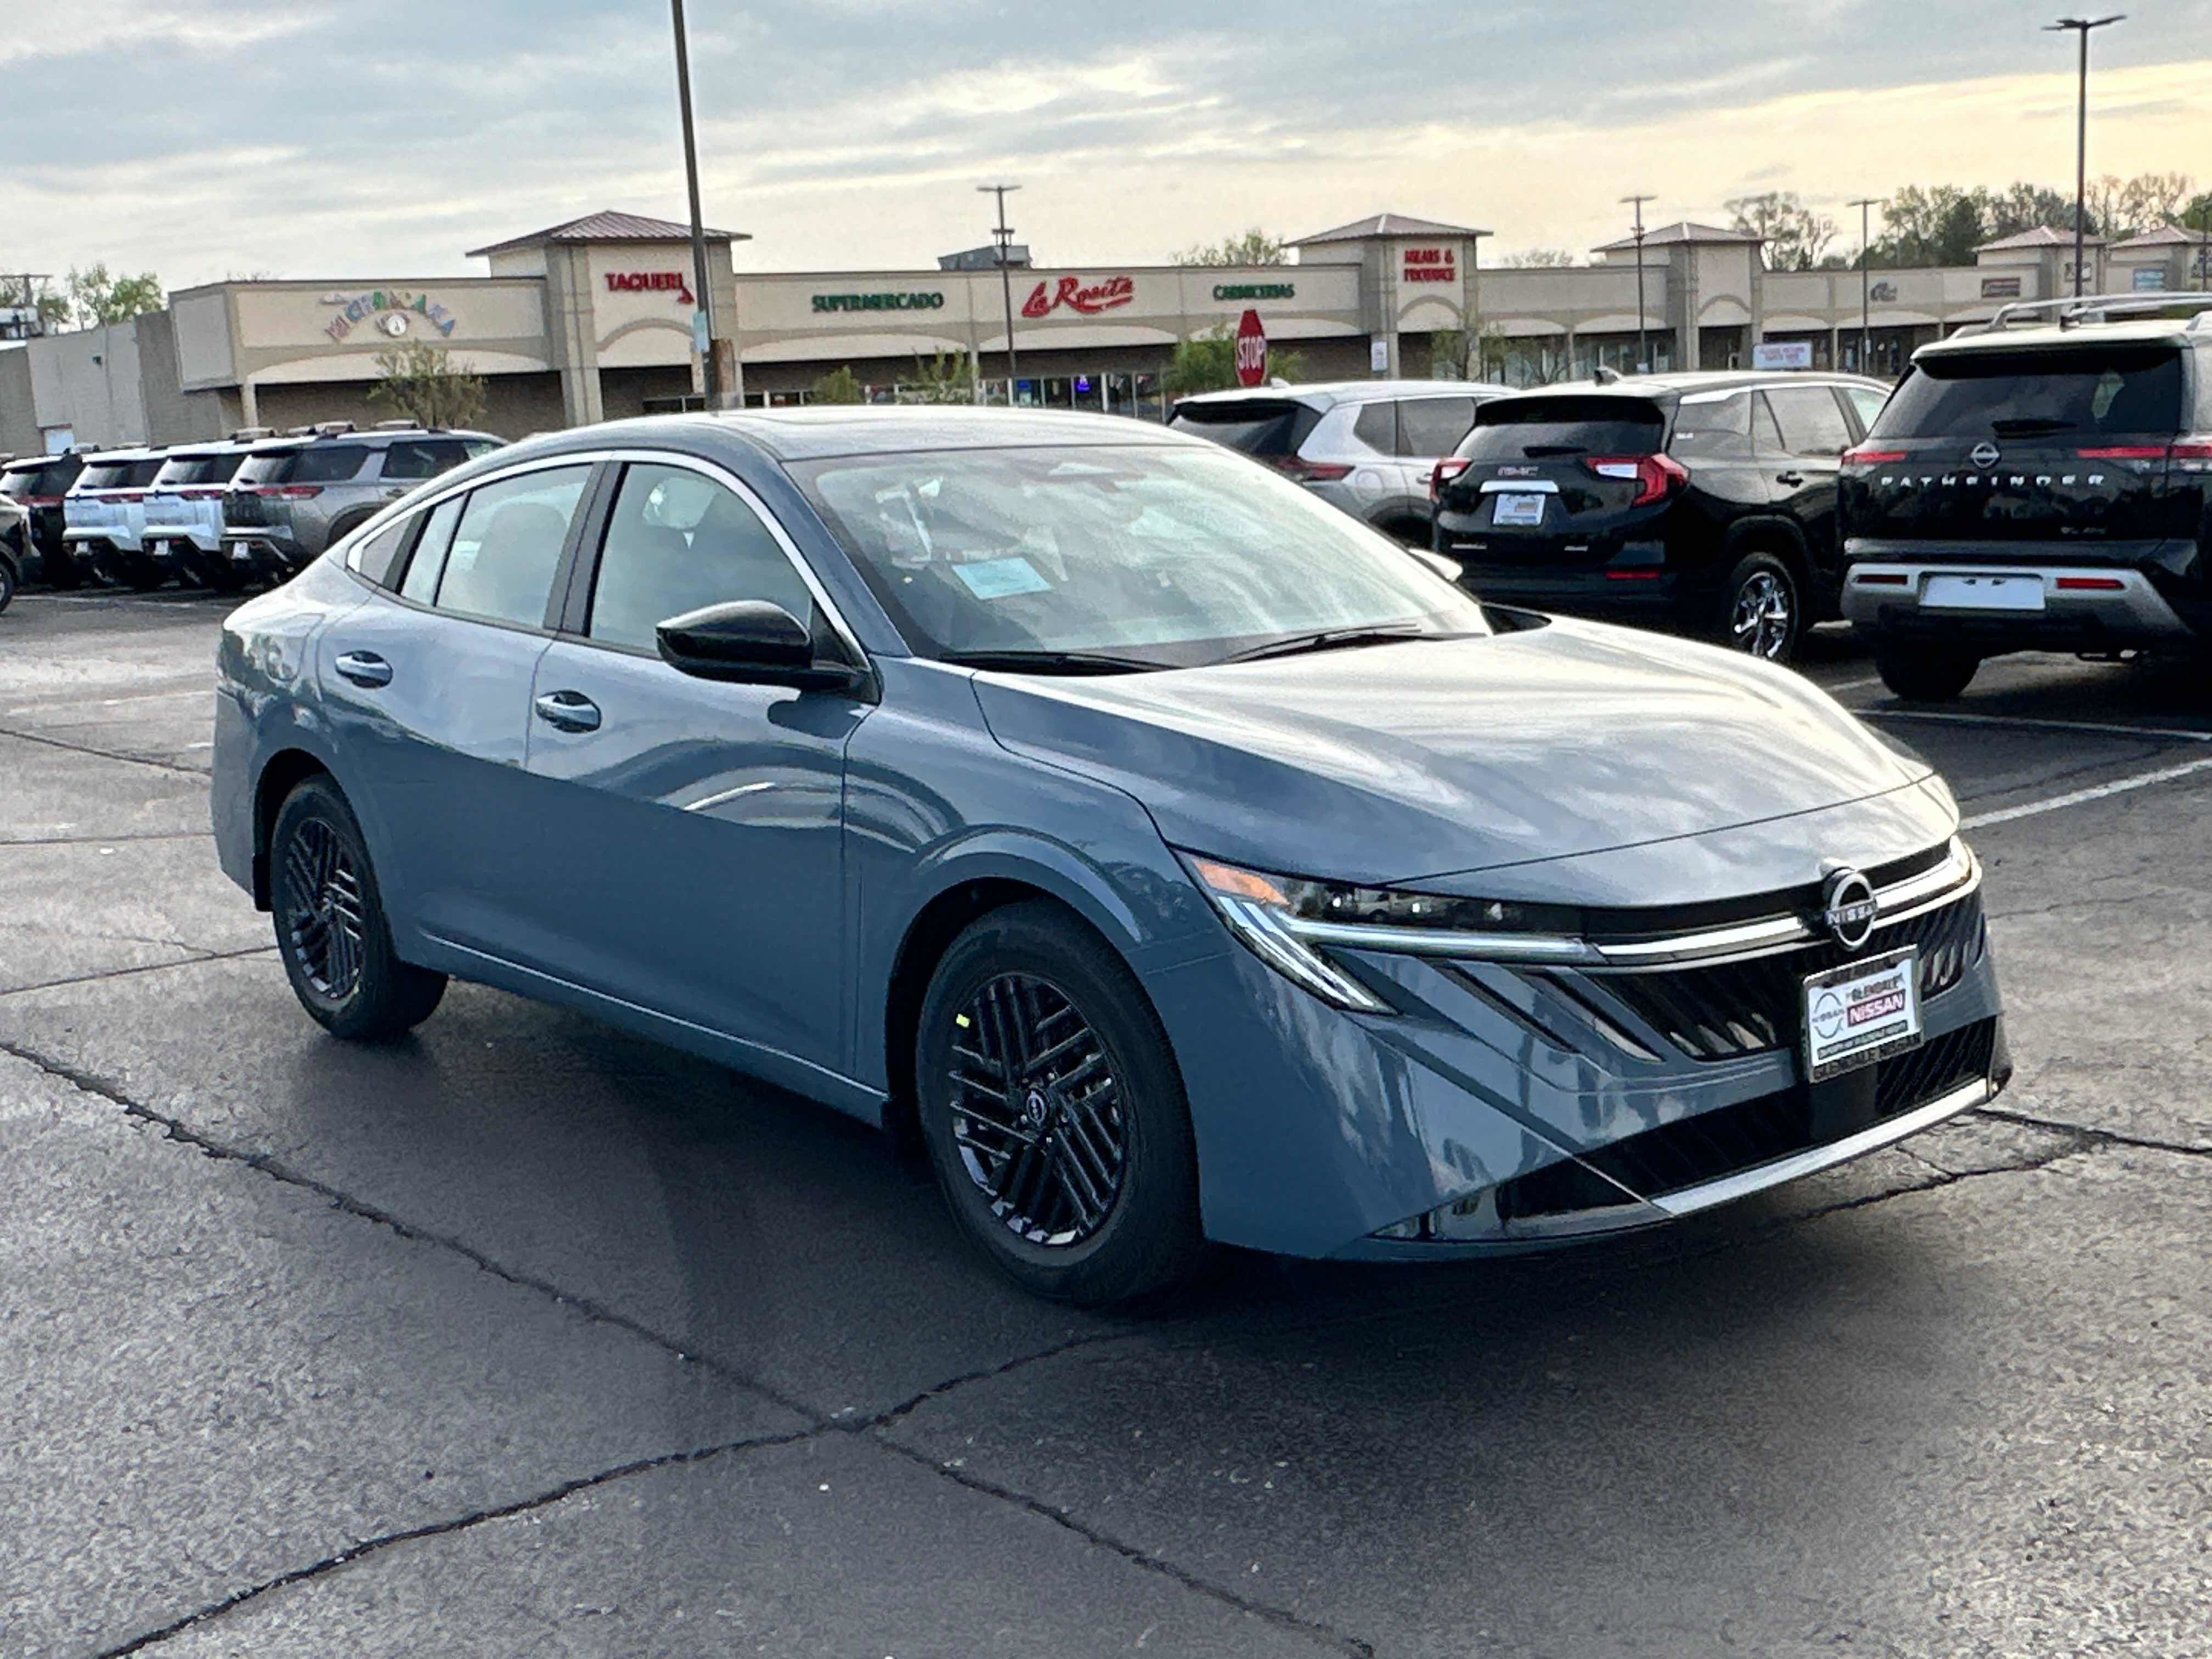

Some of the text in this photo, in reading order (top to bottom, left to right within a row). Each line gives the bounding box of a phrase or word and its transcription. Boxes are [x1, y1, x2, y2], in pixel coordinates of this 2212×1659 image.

[812, 292, 944, 313] SUPERMERCADO
[1238, 335, 1267, 370] STOP
[1881, 474, 2104, 487] PATHFINDER
[1849, 994, 1903, 1024] NISSAN
